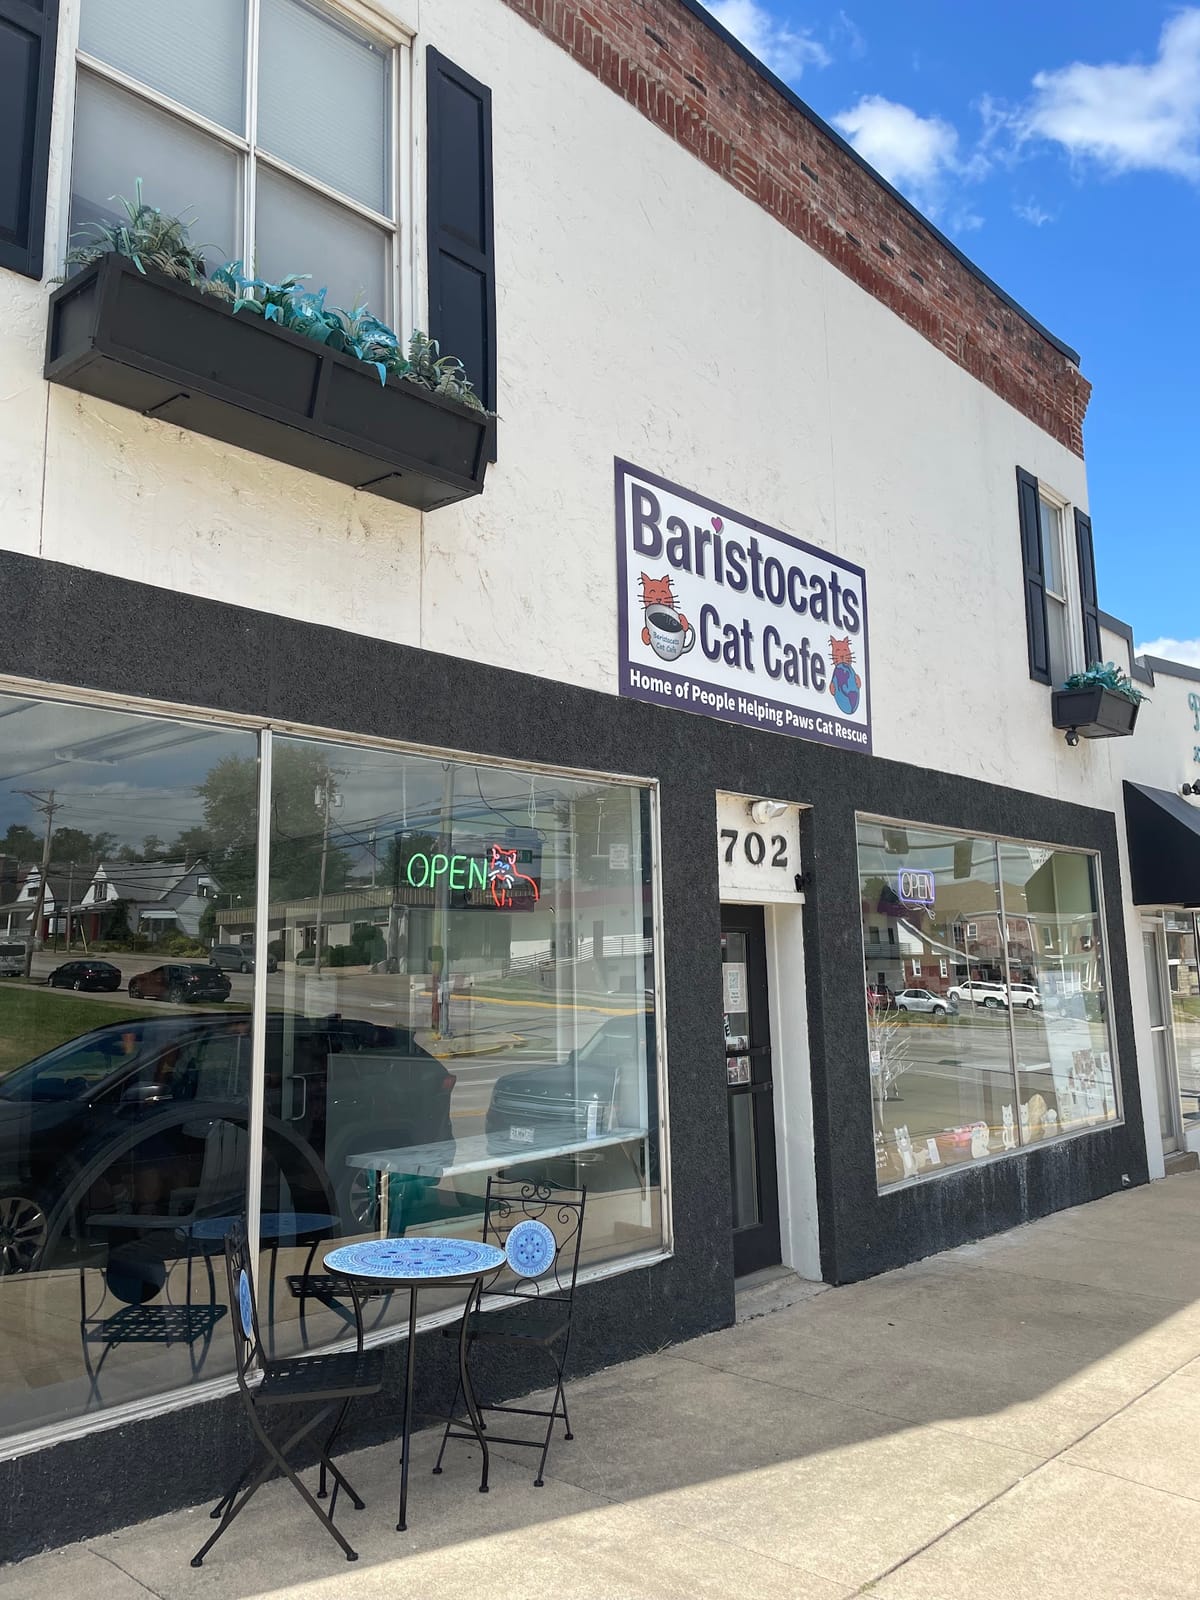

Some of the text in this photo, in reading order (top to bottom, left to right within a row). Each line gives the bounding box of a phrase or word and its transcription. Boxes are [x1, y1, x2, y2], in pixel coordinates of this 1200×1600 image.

[631, 482, 860, 634] Baristocats
[699, 603, 827, 692] Cat Cafe
[630, 668, 869, 744] Home of People Helping Paws Cat Rescue
[407, 853, 488, 890] OPEN
[720, 828, 788, 867] 702
[901, 872, 933, 899] OPEN
